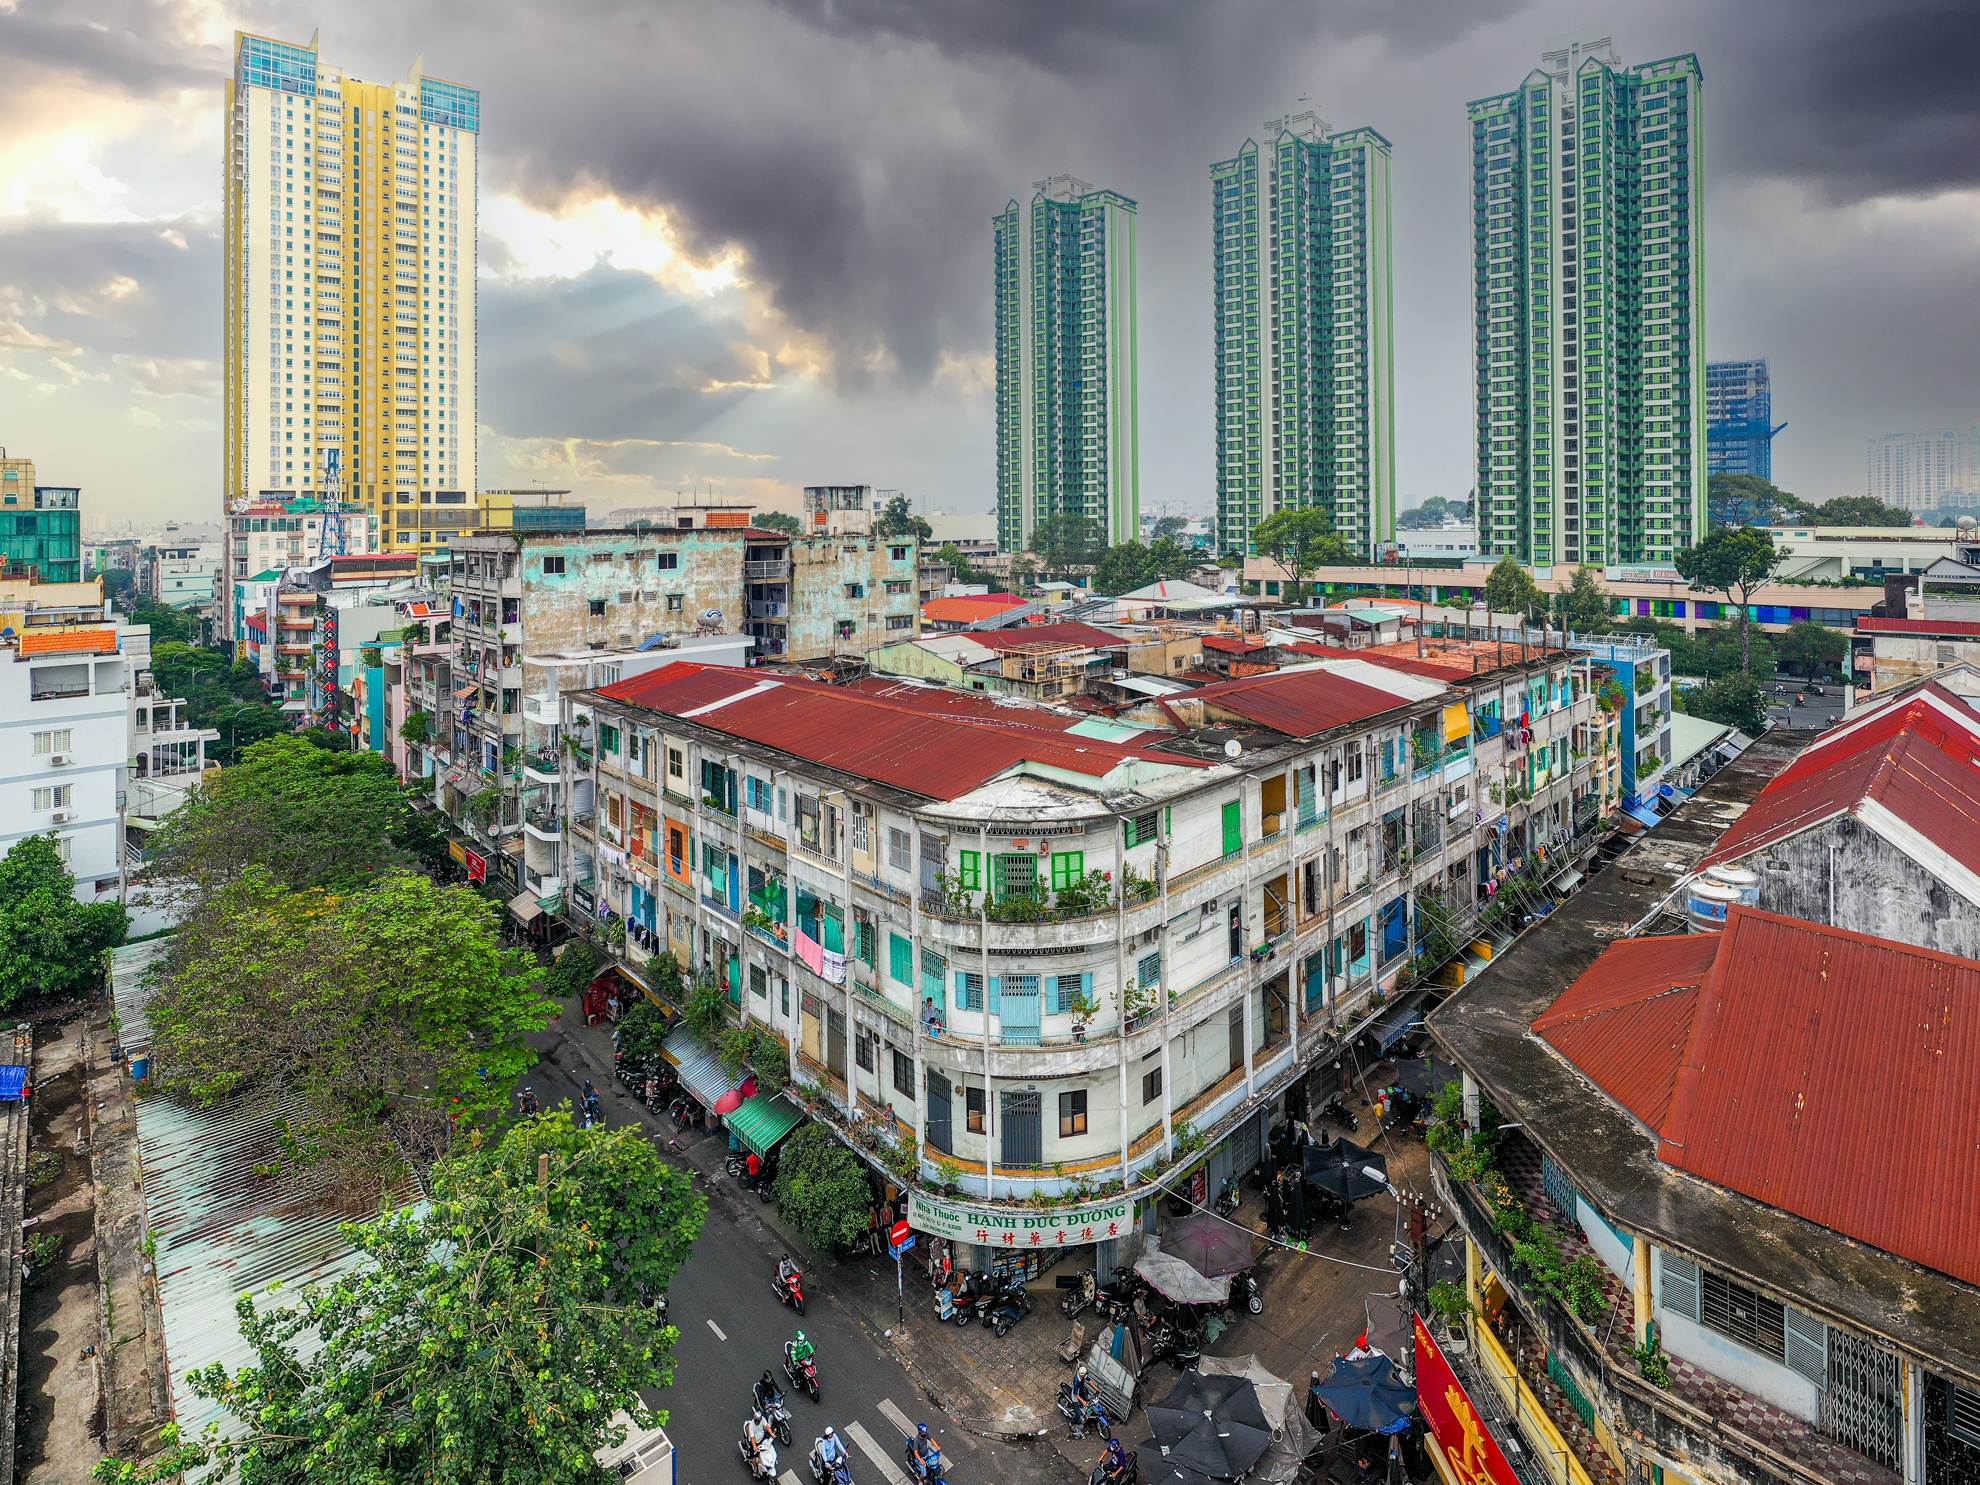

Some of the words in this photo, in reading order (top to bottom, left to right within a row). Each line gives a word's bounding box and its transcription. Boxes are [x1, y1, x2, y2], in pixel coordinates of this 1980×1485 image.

[915, 1200, 931, 1214] Nhà
[933, 1206, 960, 1222] Thuốc
[967, 1213, 1017, 1229] HẠNH
